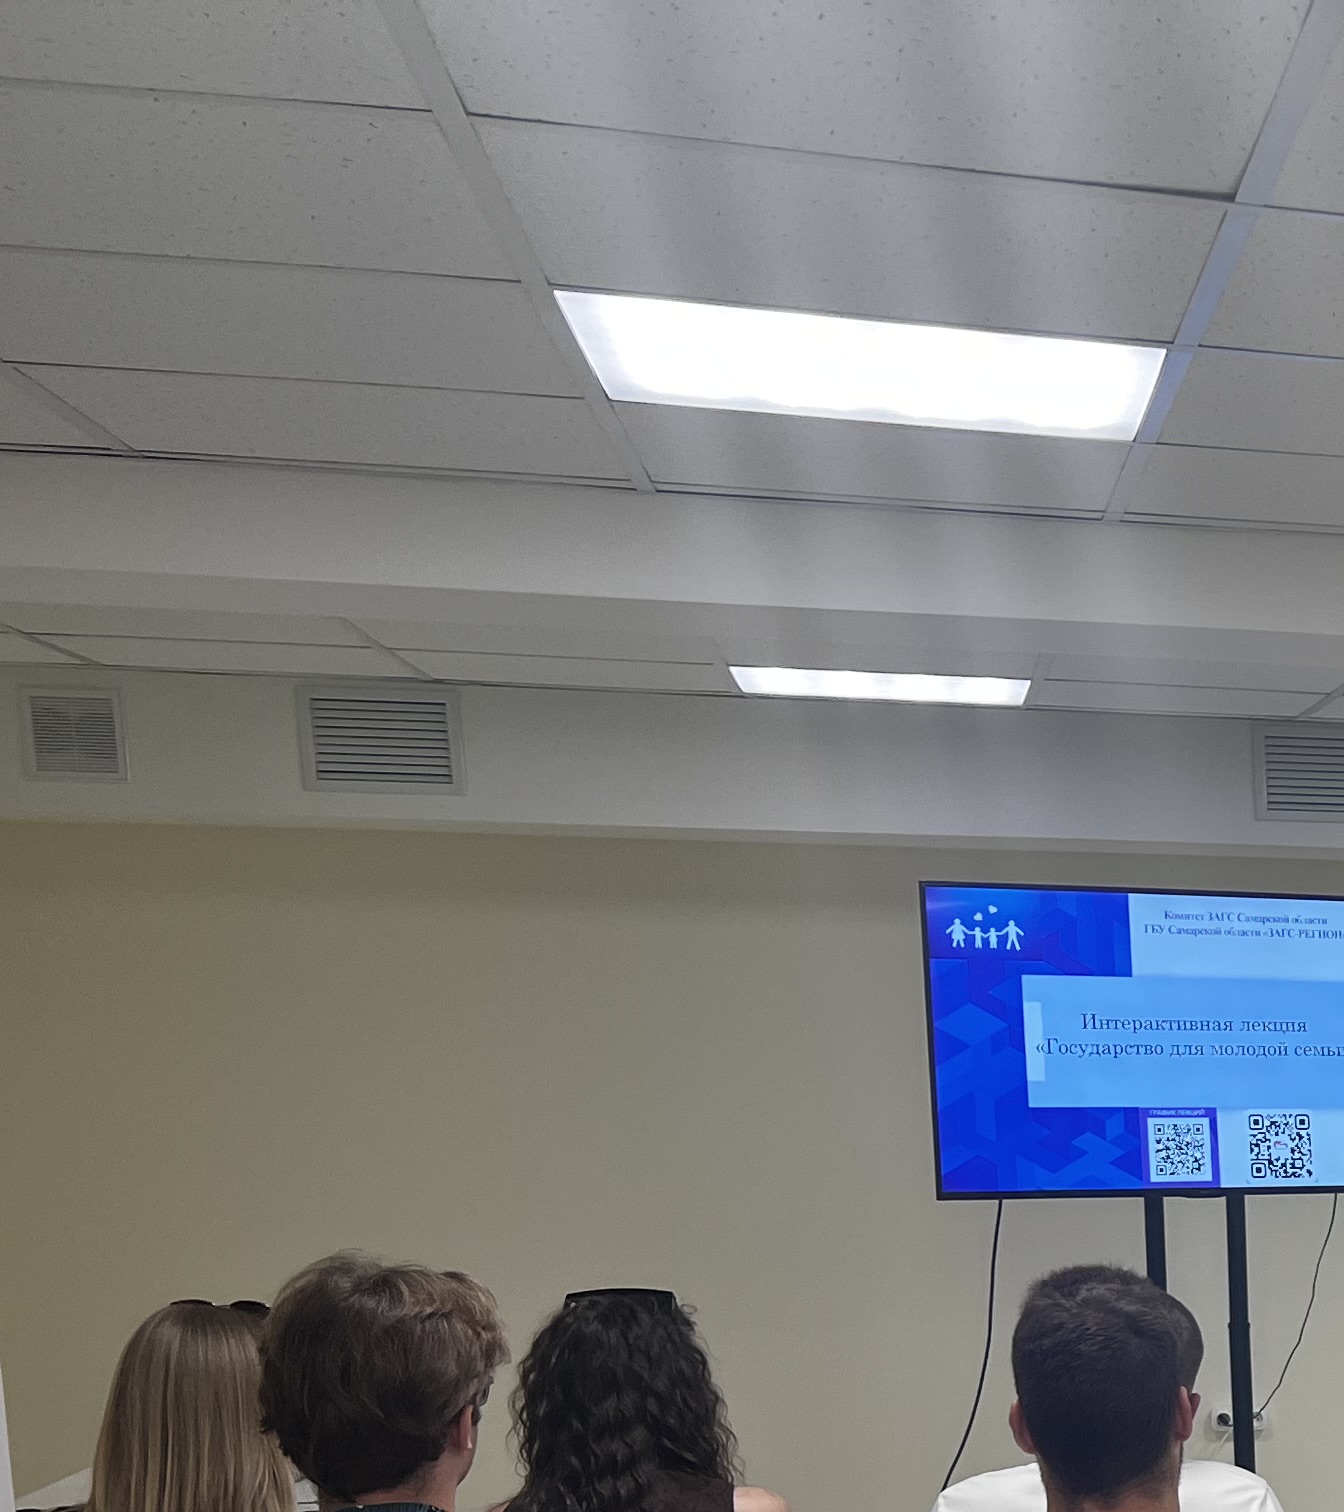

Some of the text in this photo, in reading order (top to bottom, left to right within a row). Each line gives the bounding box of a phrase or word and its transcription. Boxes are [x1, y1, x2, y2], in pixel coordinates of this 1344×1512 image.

[1207, 911, 1235, 922] ЗАГС
[1080, 1012, 1308, 1034] Интерактивная лекция
[1035, 1038, 1164, 1058] «Государство
[1169, 1043, 1205, 1057] для
[1210, 1041, 1289, 1058] молодой
